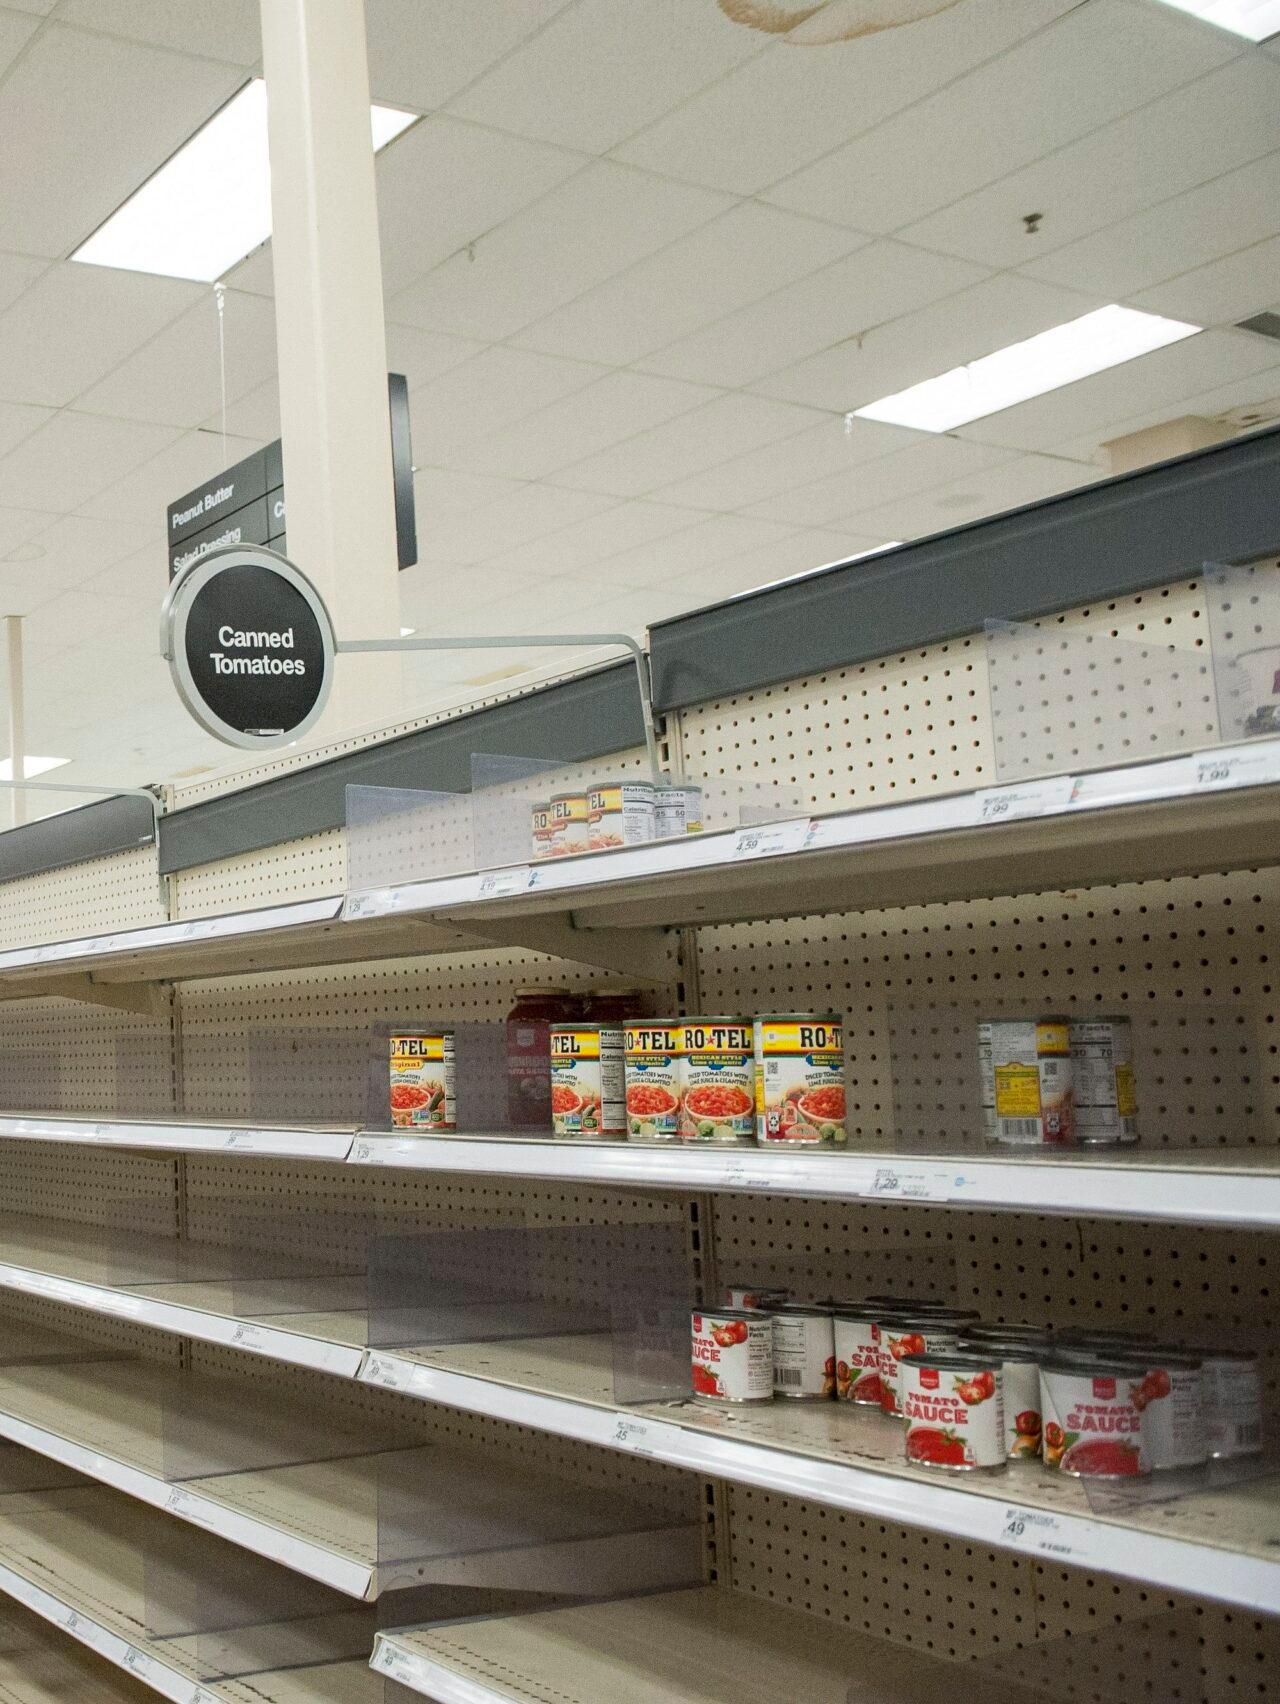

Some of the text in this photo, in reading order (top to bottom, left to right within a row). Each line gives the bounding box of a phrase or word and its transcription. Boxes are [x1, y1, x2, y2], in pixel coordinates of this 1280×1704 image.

[172, 484, 234, 528] Peanut Butter
[218, 625, 294, 648] Canned
[209, 653, 306, 675] Tomatoes
[982, 804, 1009, 817] 1.99
[736, 840, 759, 852] 4.59
[907, 1392, 960, 1408] TOMATO
[1074, 1404, 1135, 1415] TOMATO
[904, 1400, 969, 1425] SAUCE
[1066, 1413, 1141, 1434] SAUCE
